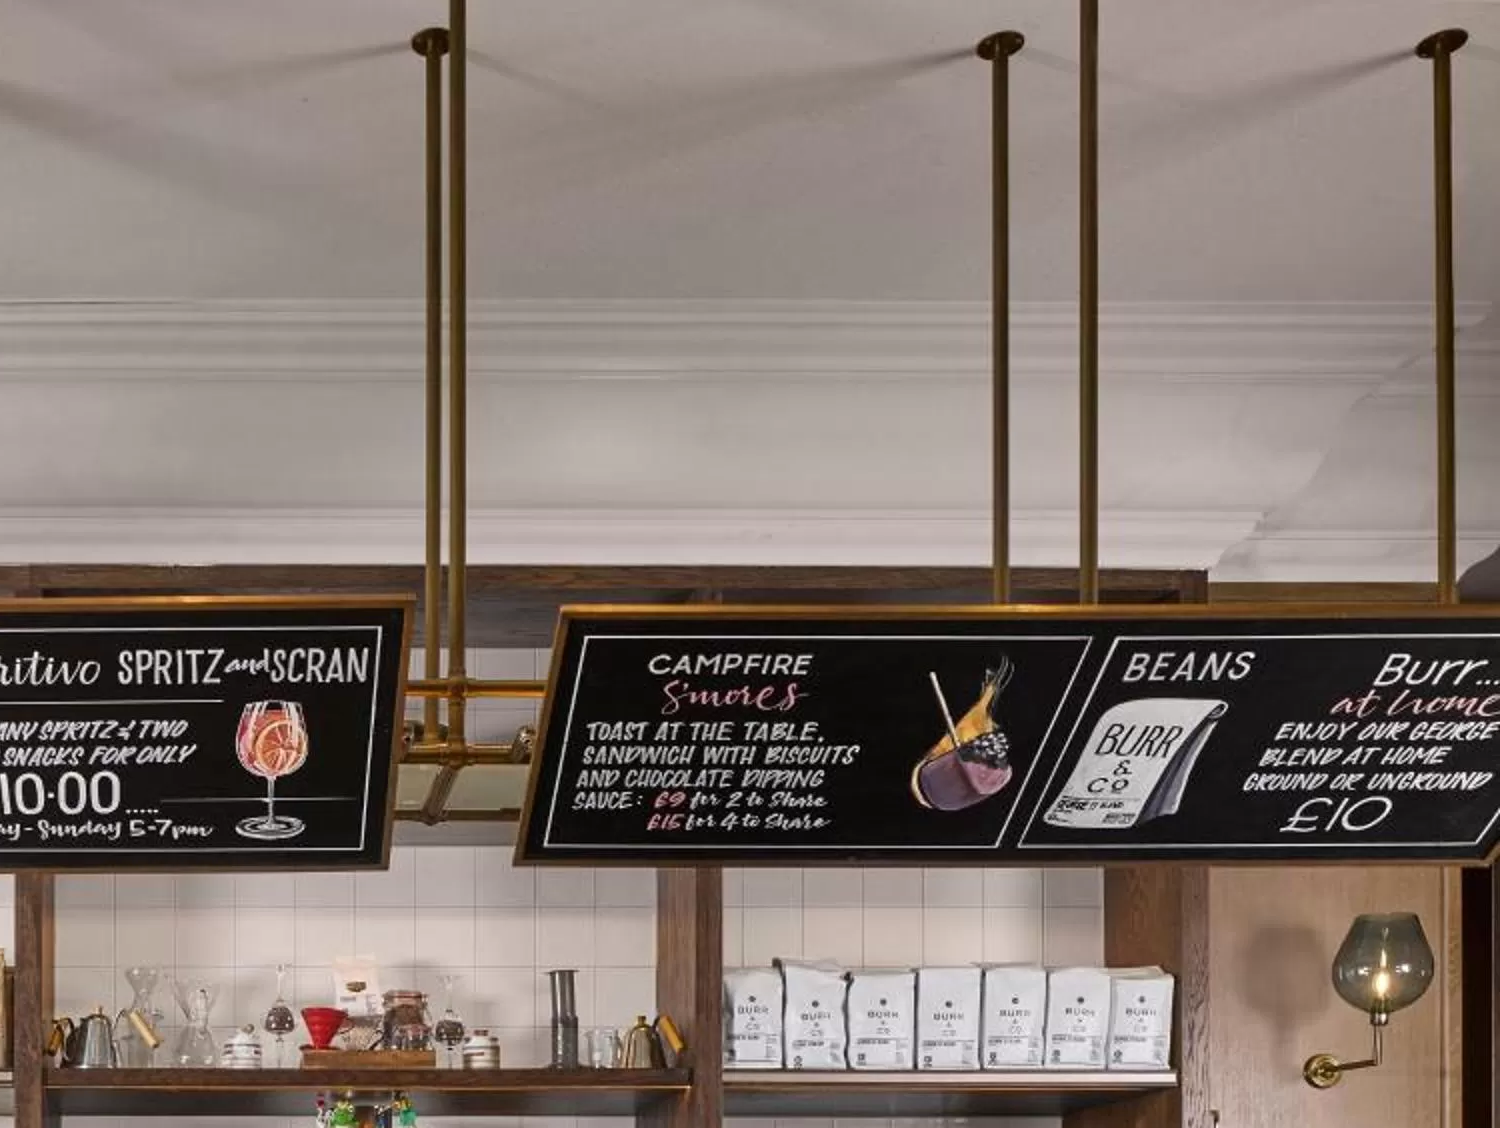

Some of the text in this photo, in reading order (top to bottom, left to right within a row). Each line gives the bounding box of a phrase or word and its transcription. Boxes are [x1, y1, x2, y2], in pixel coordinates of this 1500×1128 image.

[117, 648, 225, 685] SPRITZ
[224, 648, 270, 675] and
[270, 647, 369, 683] SCRAN
[648, 653, 814, 675] CAMPFIRE
[1122, 651, 1256, 682] BEANS
[661, 679, 810, 715] S'mores
[1330, 689, 1500, 719] at home
[38, 720, 119, 741] SPRITZ
[138, 719, 189, 739] TWO
[586, 721, 649, 741] TOAST
[654, 721, 686, 741] AT
[690, 721, 735, 741] THE
[1094, 723, 1185, 758] BURR
[1274, 721, 1500, 741] ENJOY OUR GEORGE
[2, 746, 85, 767] SNACKS
[89, 745, 138, 765] FOR
[136, 743, 197, 765] ONLY
[582, 745, 861, 765] SANDWICH WITH BISCUITS
[1258, 745, 1453, 767] BLEND AT HOME
[576, 769, 826, 789] AND CHOCOLATE DIPPING
[1113, 759, 1133, 777] &
[1243, 771, 1494, 791] GROUND OR UNGROUND
[689, 791, 721, 810] for
[725, 791, 743, 809] 2
[746, 791, 764, 807] to
[685, 813, 717, 831] for
[720, 811, 738, 831] 4
[742, 813, 761, 828] to
[1279, 796, 1393, 833] £10
[129, 819, 213, 840] 5-7pm
